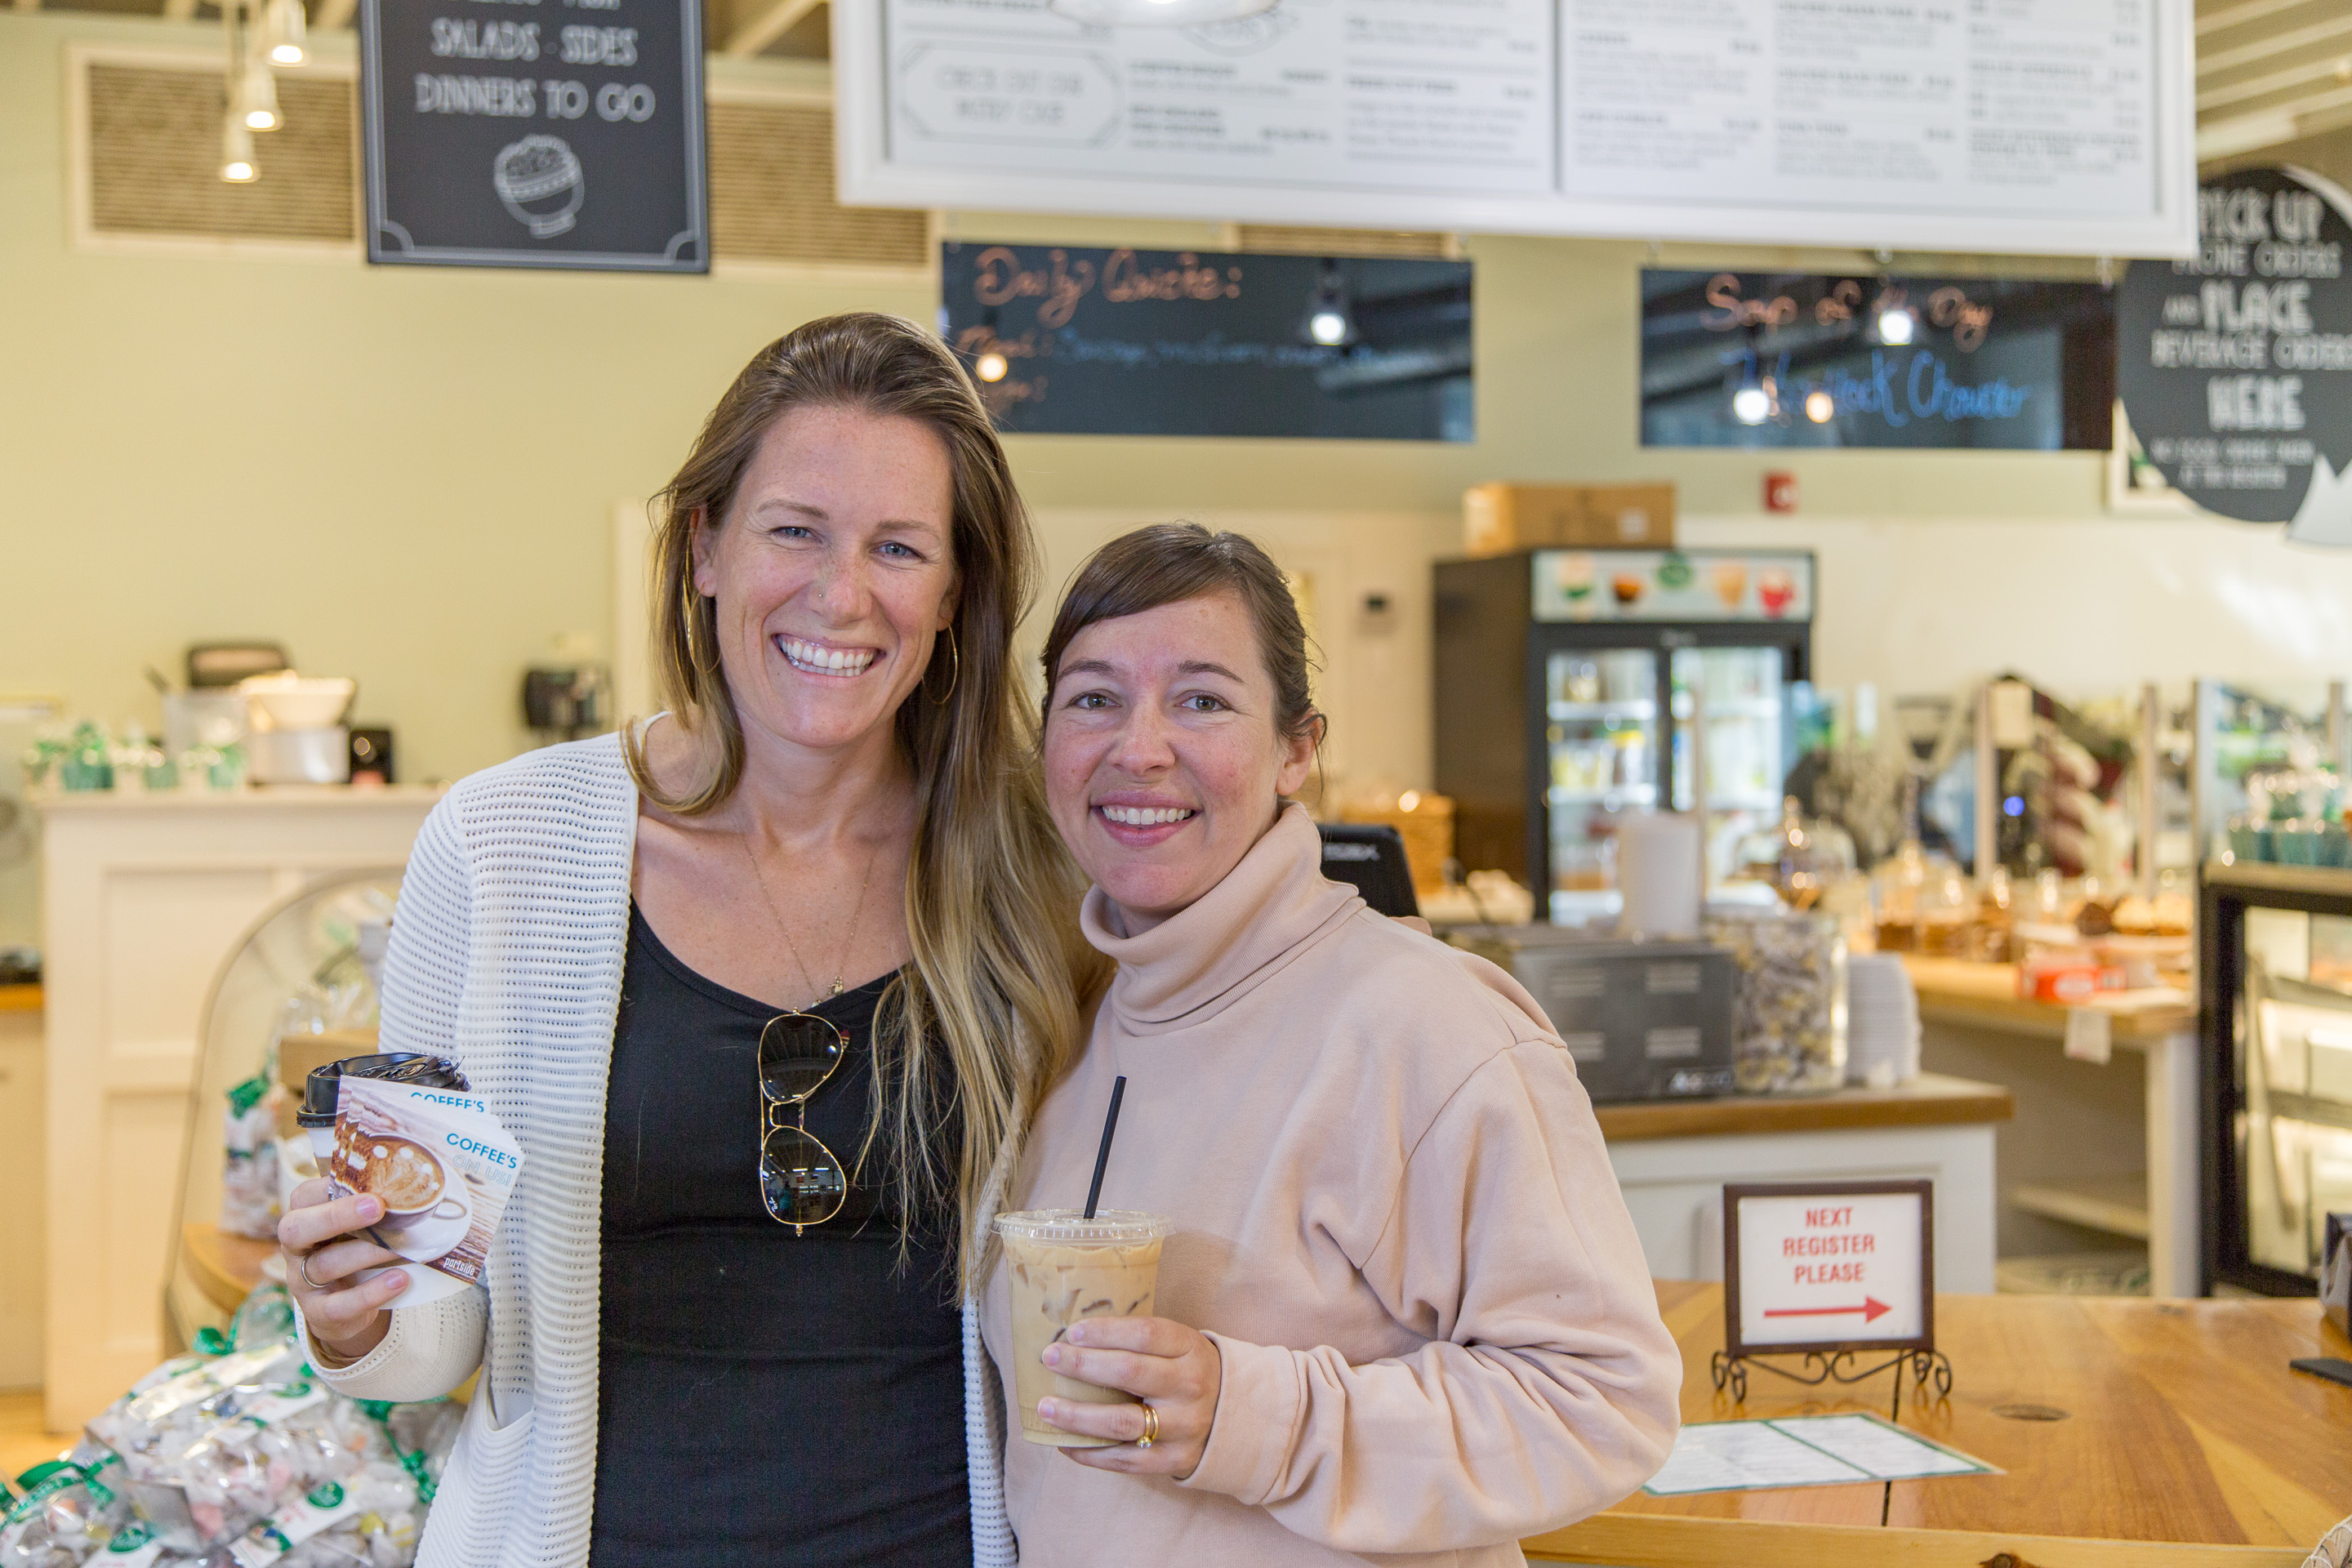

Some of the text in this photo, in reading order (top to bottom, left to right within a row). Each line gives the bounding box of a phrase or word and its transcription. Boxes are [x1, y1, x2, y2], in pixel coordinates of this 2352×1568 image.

[431, 16, 638, 66] SALADS SIDES
[413, 72, 656, 122] DINNERS TO GO
[2274, 189, 2323, 243] UP
[2254, 241, 2342, 278] ORDERS
[974, 246, 1096, 328] Daily
[2200, 279, 2314, 334] PLACE
[1928, 286, 1993, 353] Day
[2151, 328, 2268, 368] BEVERAGE
[2207, 374, 2306, 432] HERE
[446, 1133, 518, 1169] COFFEE'S
[452, 1154, 512, 1187] ON US!
[1805, 1207, 1854, 1228] NEXT
[1783, 1234, 1875, 1257] REGISTER
[443, 1257, 476, 1276] portside
[1793, 1263, 1865, 1285] PLEASE
